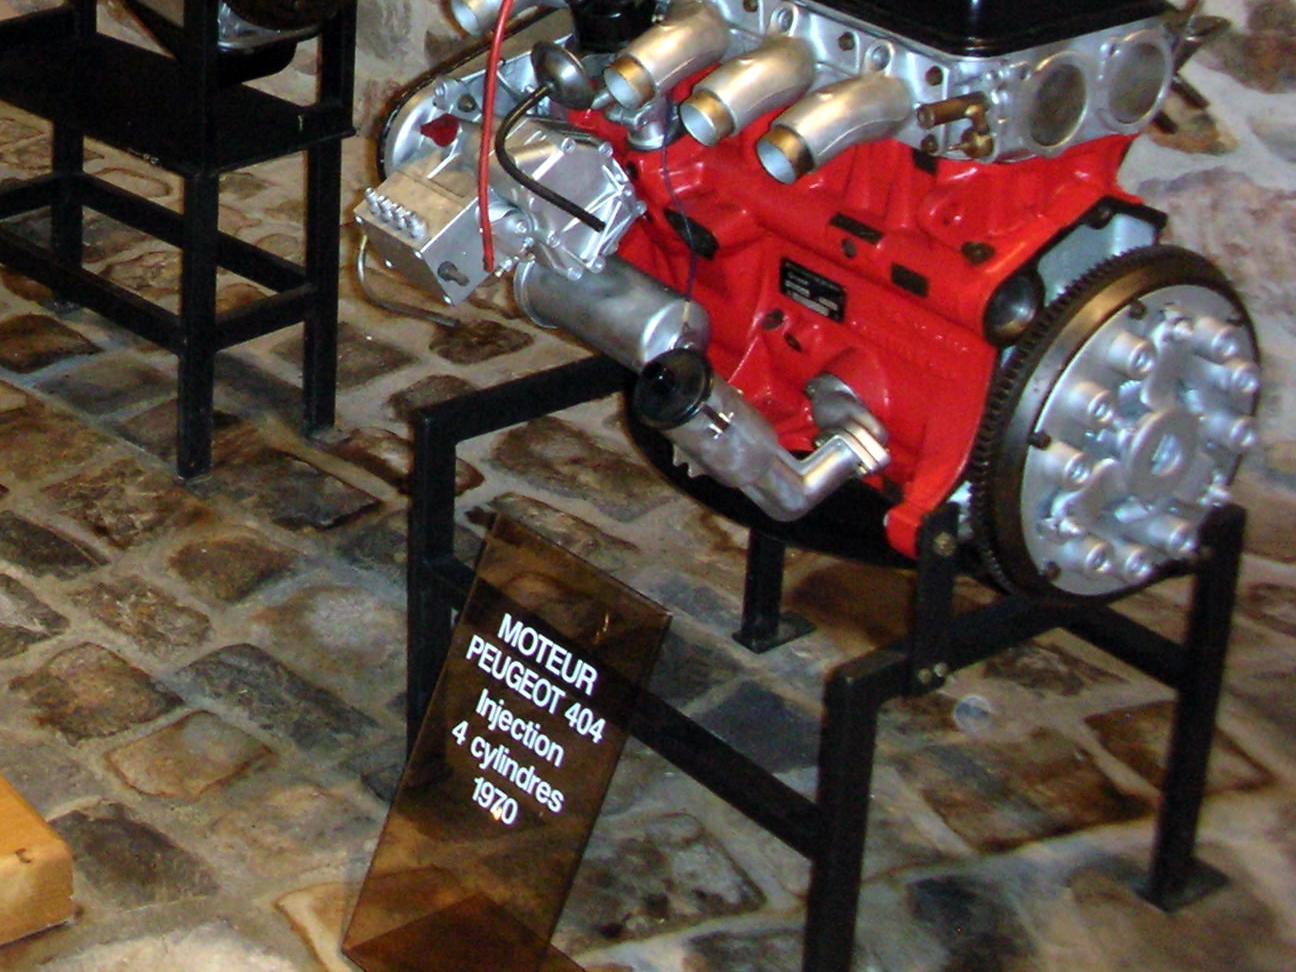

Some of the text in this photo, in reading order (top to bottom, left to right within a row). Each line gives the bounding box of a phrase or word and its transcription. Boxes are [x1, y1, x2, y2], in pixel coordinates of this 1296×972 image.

[466, 635, 606, 744] PEUGEOT 404
[498, 613, 598, 696] MOTEUR
[452, 721, 565, 814] 4 cylindres
[475, 689, 566, 768] Injection
[473, 777, 520, 826] 1970
